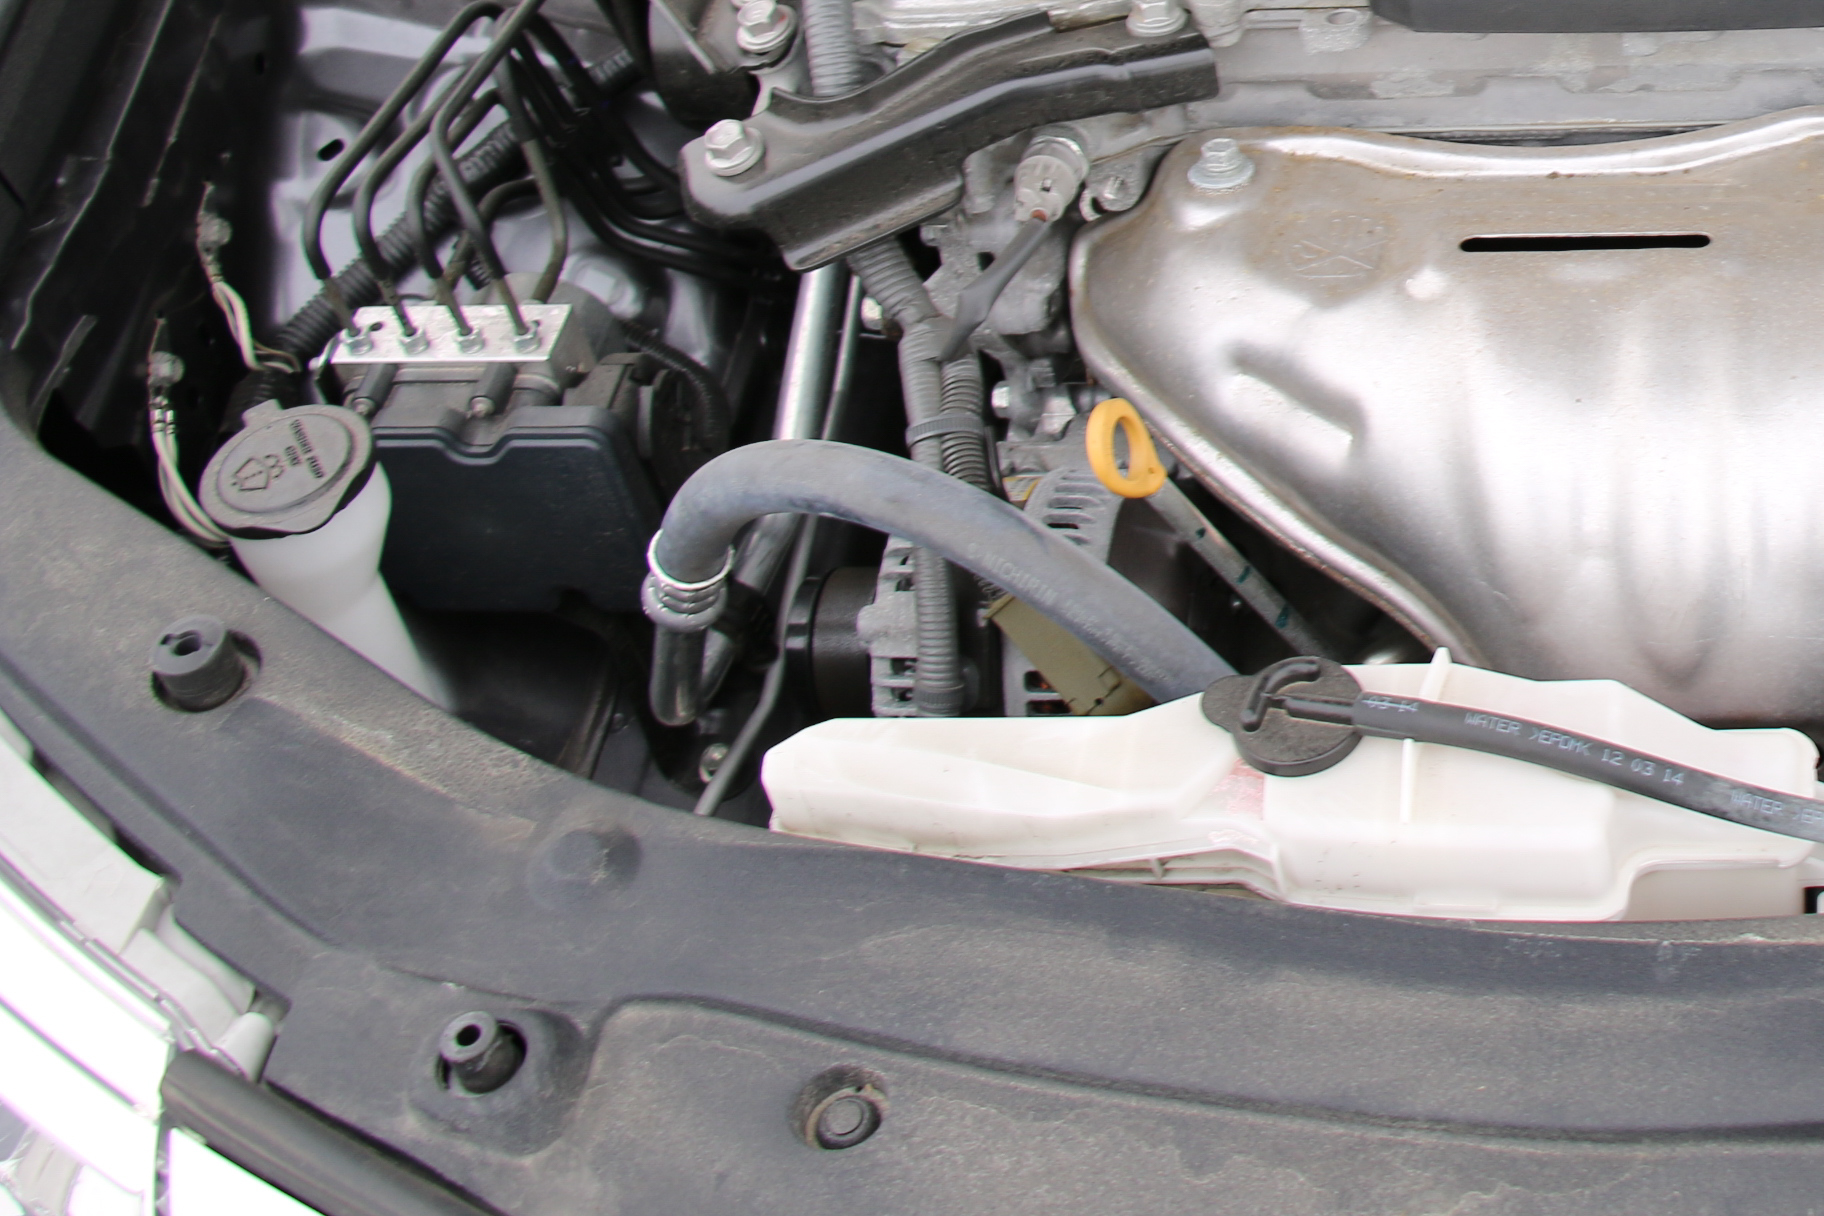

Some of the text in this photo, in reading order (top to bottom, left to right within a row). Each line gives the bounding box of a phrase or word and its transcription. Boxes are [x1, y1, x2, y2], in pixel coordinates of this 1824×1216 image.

[284, 445, 303, 466] ONLY
[290, 419, 326, 479] WASHER FLUID
[1464, 712, 1523, 736] WATER
[1601, 748, 1625, 767] 12
[1630, 758, 1656, 776] 03
[1662, 768, 1685, 786] 14
[1730, 790, 1784, 816] WATER
